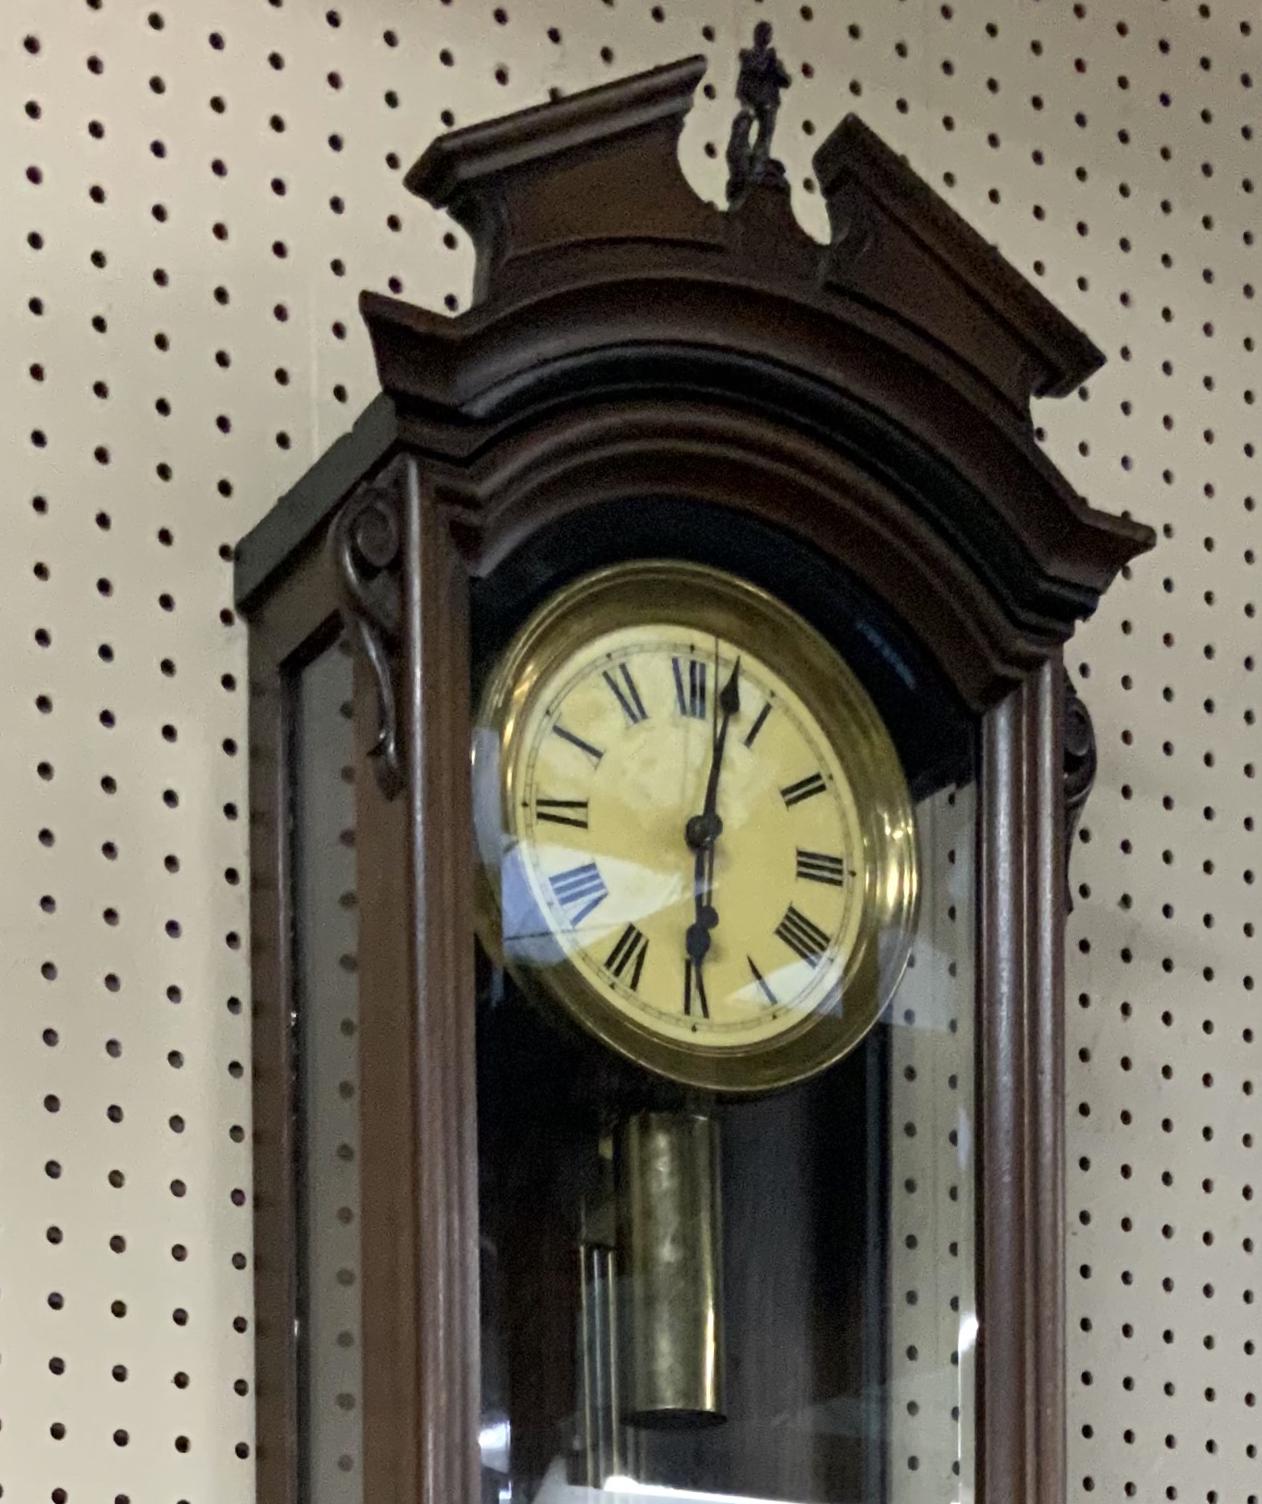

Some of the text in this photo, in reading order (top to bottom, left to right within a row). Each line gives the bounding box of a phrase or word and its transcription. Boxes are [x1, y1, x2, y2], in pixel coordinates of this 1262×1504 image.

[601, 661, 652, 730] XI
[669, 655, 708, 721] XII
[743, 700, 773, 750] I
[535, 797, 589, 831] IX
[779, 771, 828, 812] II
[548, 862, 609, 929] VIII
[796, 848, 844, 888] III
[603, 921, 651, 993] VII
